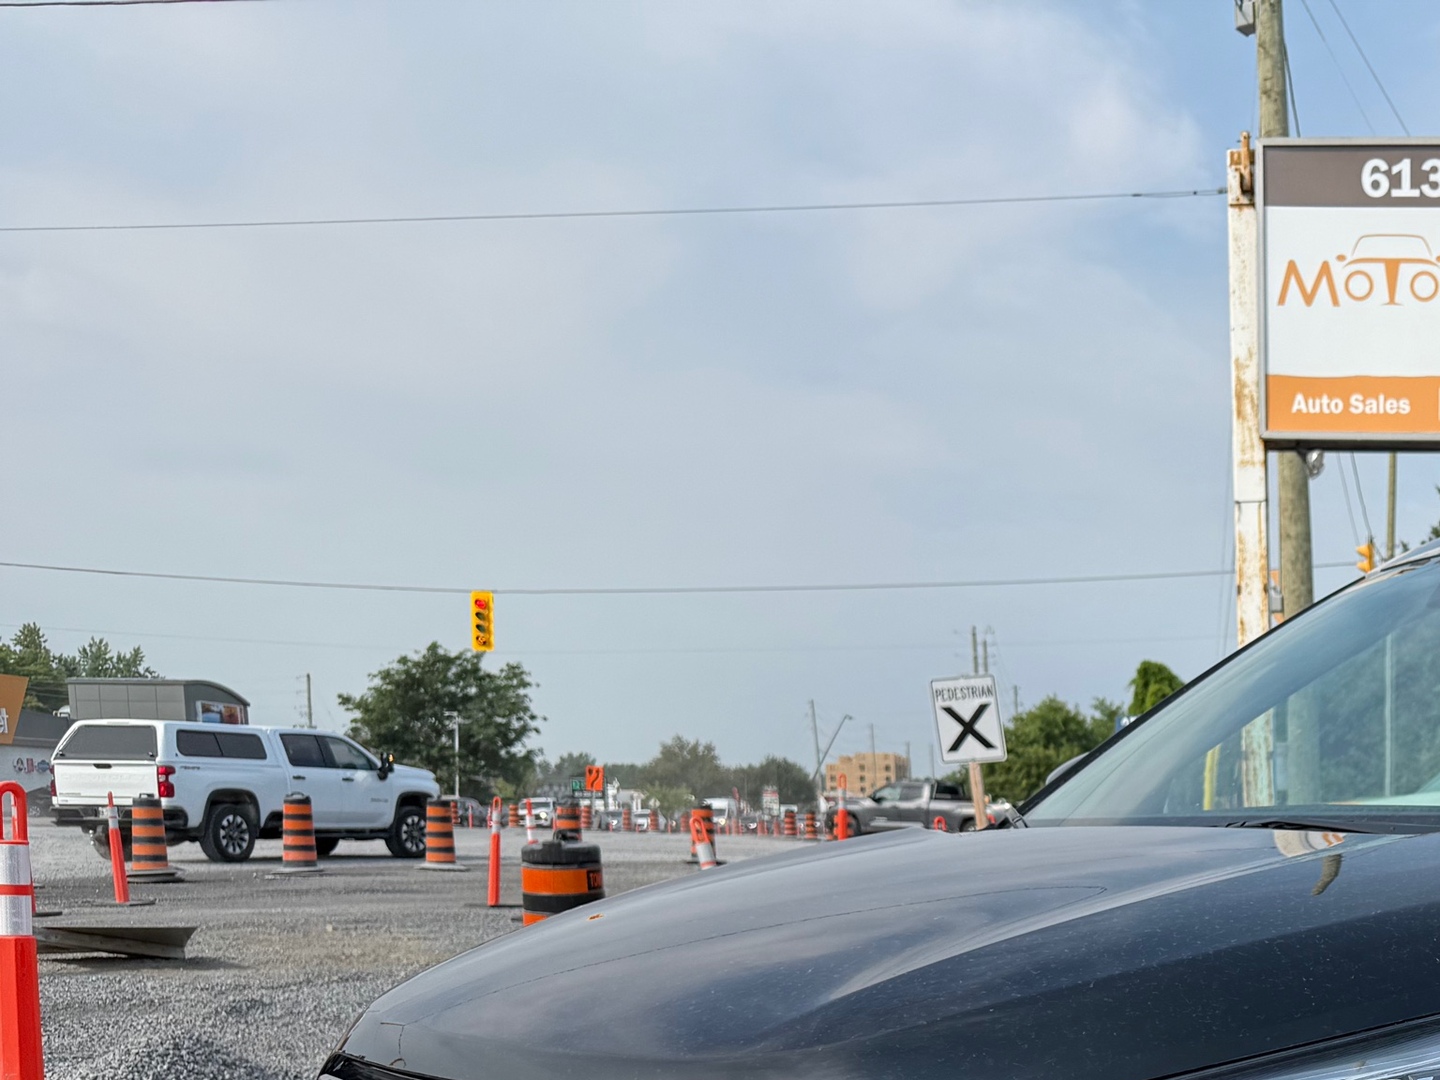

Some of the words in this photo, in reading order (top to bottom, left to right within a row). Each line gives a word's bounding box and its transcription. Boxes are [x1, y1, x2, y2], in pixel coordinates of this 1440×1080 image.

[1292, 393, 1343, 414] Auto
[1349, 393, 1411, 414] Sales
[935, 684, 994, 702] PEDESTRIAN
